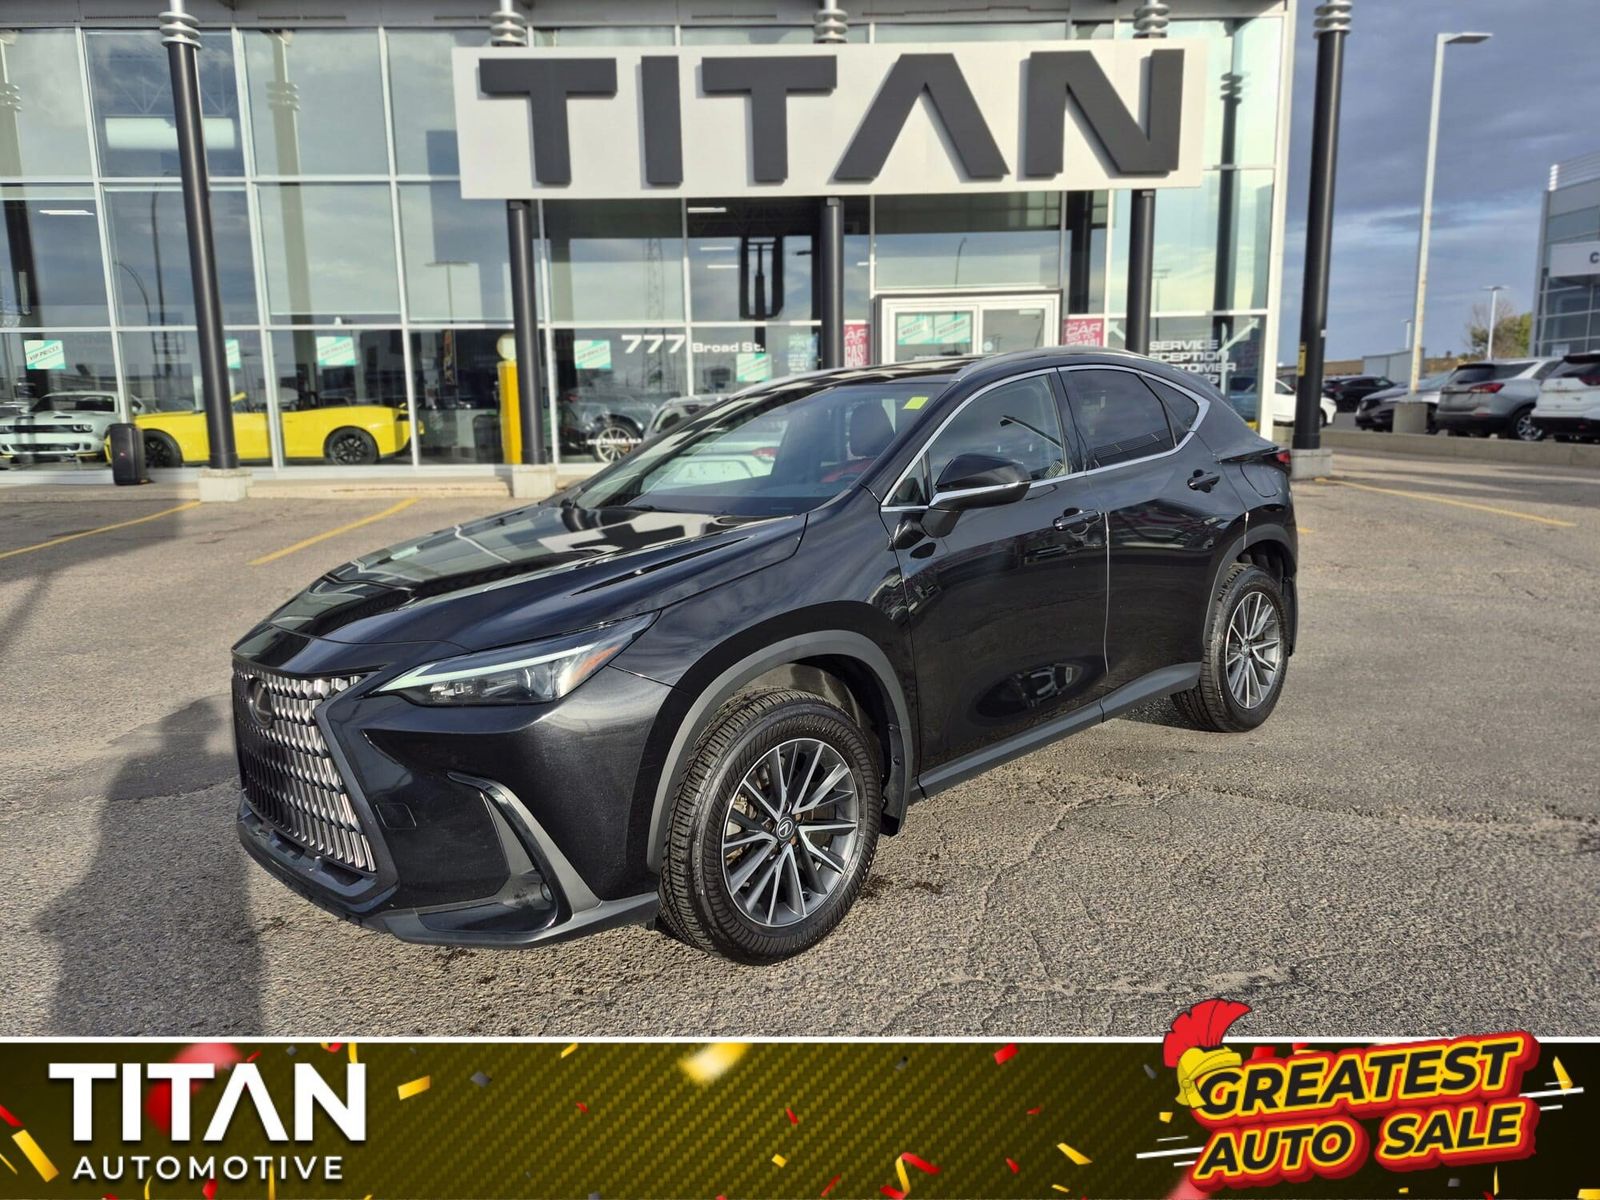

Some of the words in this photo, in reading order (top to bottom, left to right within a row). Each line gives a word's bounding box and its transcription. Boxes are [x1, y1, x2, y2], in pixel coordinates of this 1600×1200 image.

[479, 48, 1185, 185] TITAN
[621, 335, 685, 353] 777
[692, 342, 740, 353] Broad
[742, 340, 765, 352] St.
[1149, 339, 1219, 350] SERVICE
[1148, 351, 1229, 361] ECEPTION
